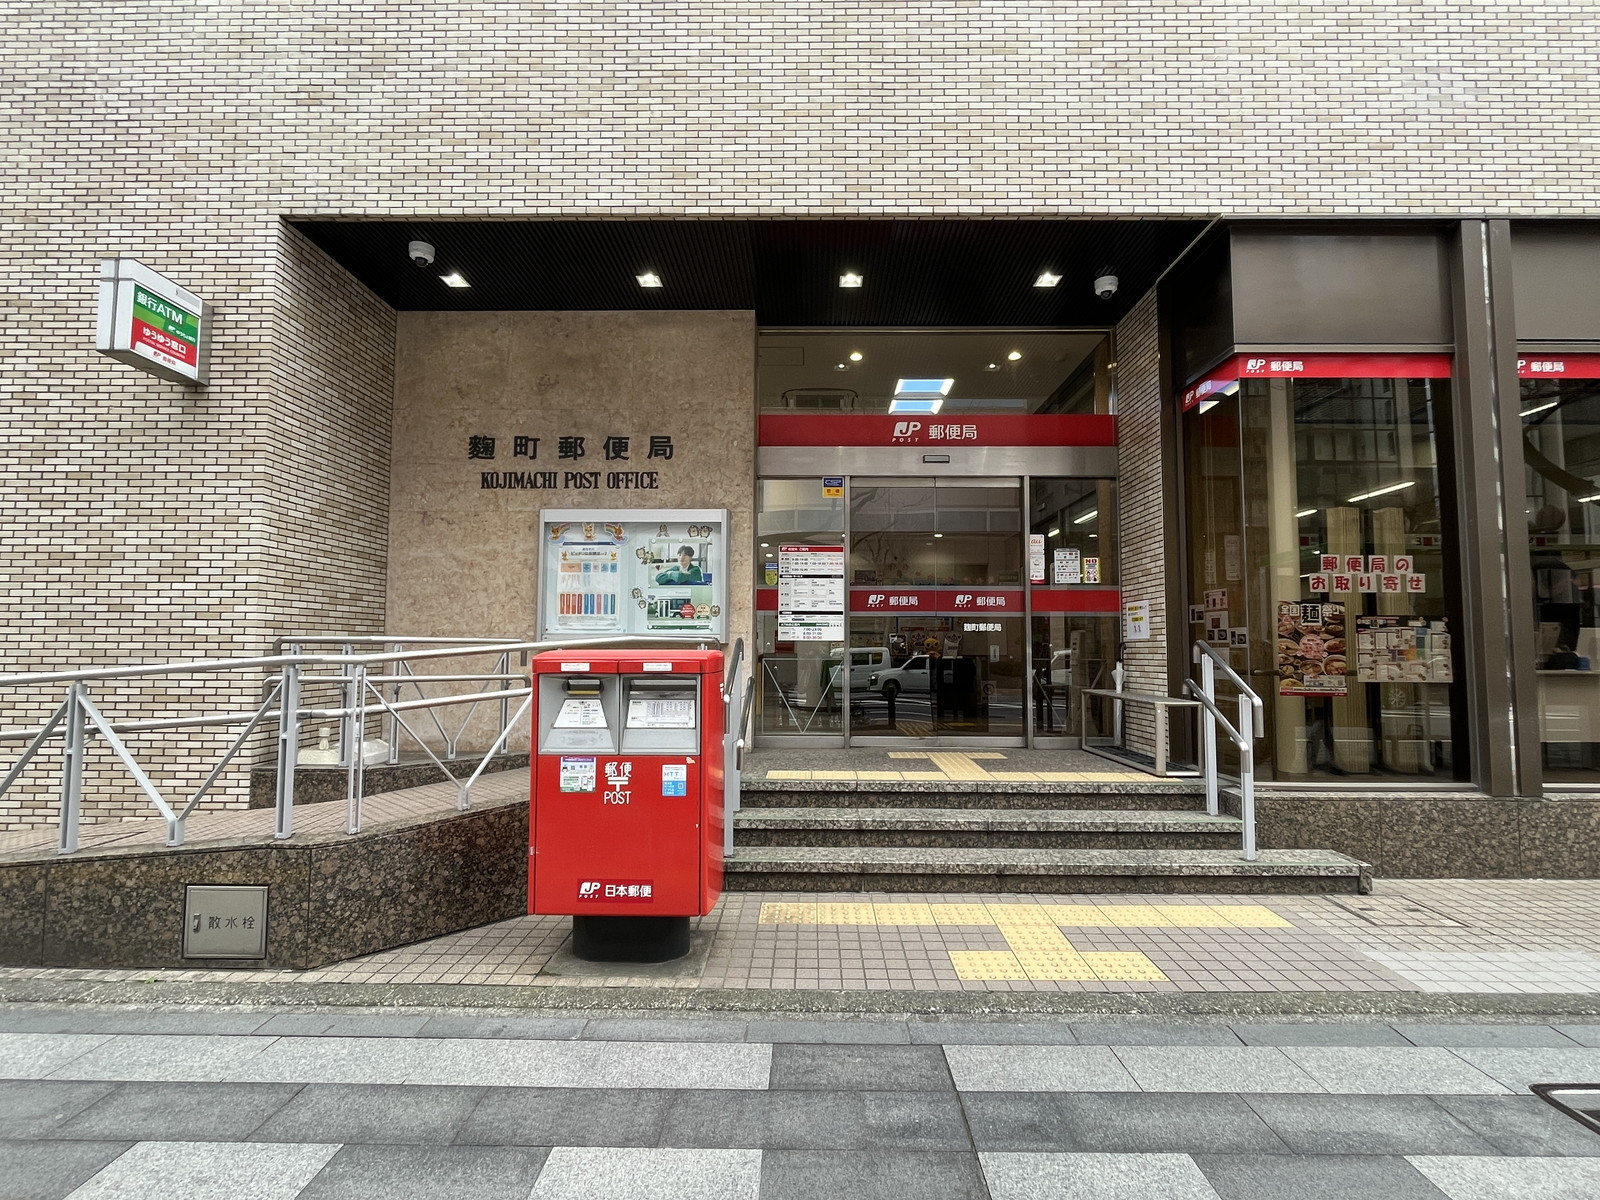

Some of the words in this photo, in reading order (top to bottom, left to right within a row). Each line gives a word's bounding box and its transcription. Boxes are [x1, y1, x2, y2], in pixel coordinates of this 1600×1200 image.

[137, 291, 183, 325] 銀行ATM
[143, 326, 187, 354] ゆうゆう窓口
[1270, 361, 1304, 372] 郵便局
[1530, 361, 1565, 373] 郵便局
[928, 424, 977, 440] 郵便局
[480, 471, 558, 489] KOJIMACHI
[563, 471, 601, 489] POST
[606, 471, 659, 489] OFFICE
[1322, 556, 1409, 573] 郵便局の
[1311, 576, 1422, 591] お取り寄せ
[889, 596, 918, 606] 郵便局
[976, 596, 1006, 606] 郵便局
[604, 762, 632, 778] 郵便
[604, 791, 632, 804] POST
[605, 885, 652, 897] 日本郵便
[208, 916, 255, 929] 散水栓
